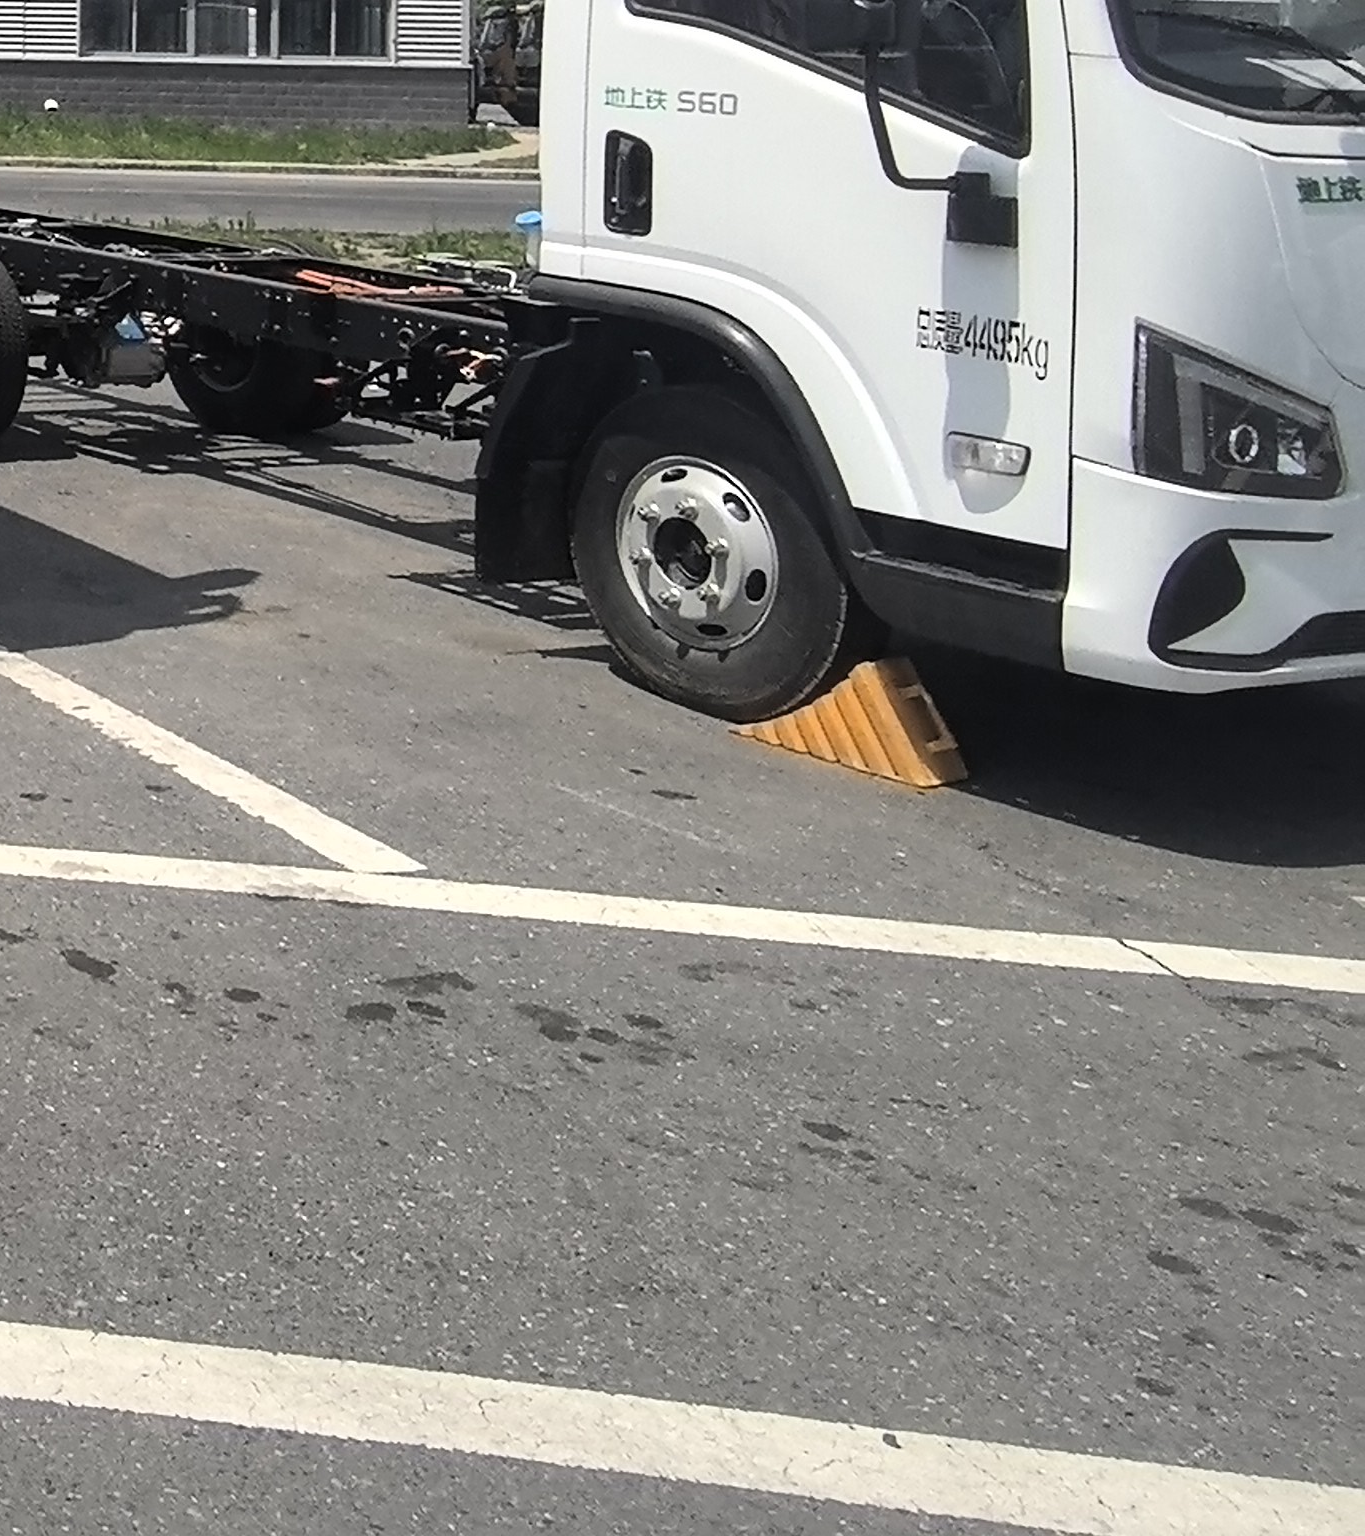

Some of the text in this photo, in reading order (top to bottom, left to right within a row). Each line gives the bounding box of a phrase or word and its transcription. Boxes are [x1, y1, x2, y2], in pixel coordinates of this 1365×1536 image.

[604, 85, 739, 116] 地上铁 S60
